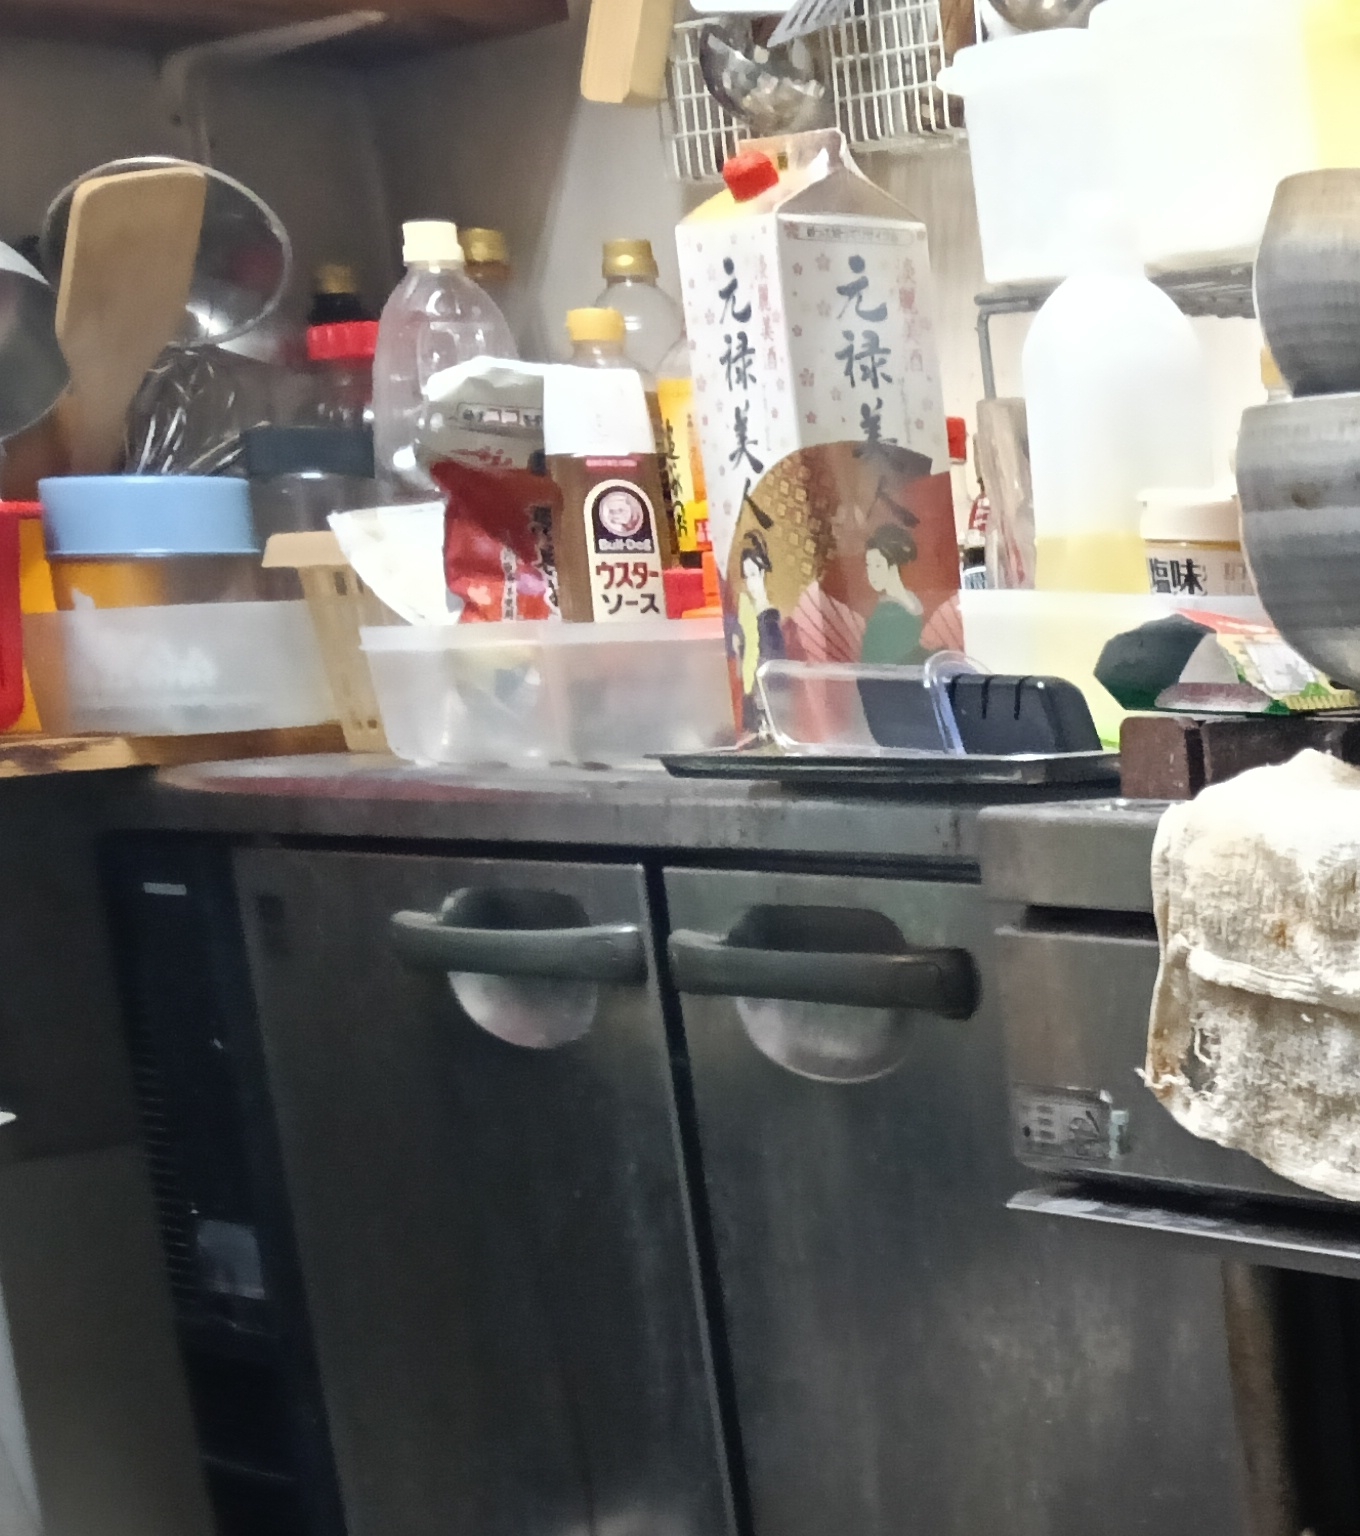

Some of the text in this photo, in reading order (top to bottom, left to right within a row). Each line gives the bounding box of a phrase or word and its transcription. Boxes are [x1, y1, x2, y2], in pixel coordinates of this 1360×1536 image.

[718, 255, 775, 530] 元禄美人
[834, 253, 922, 528] 元禄美人
[595, 561, 660, 591] ウスター
[601, 593, 661, 615] ソース
